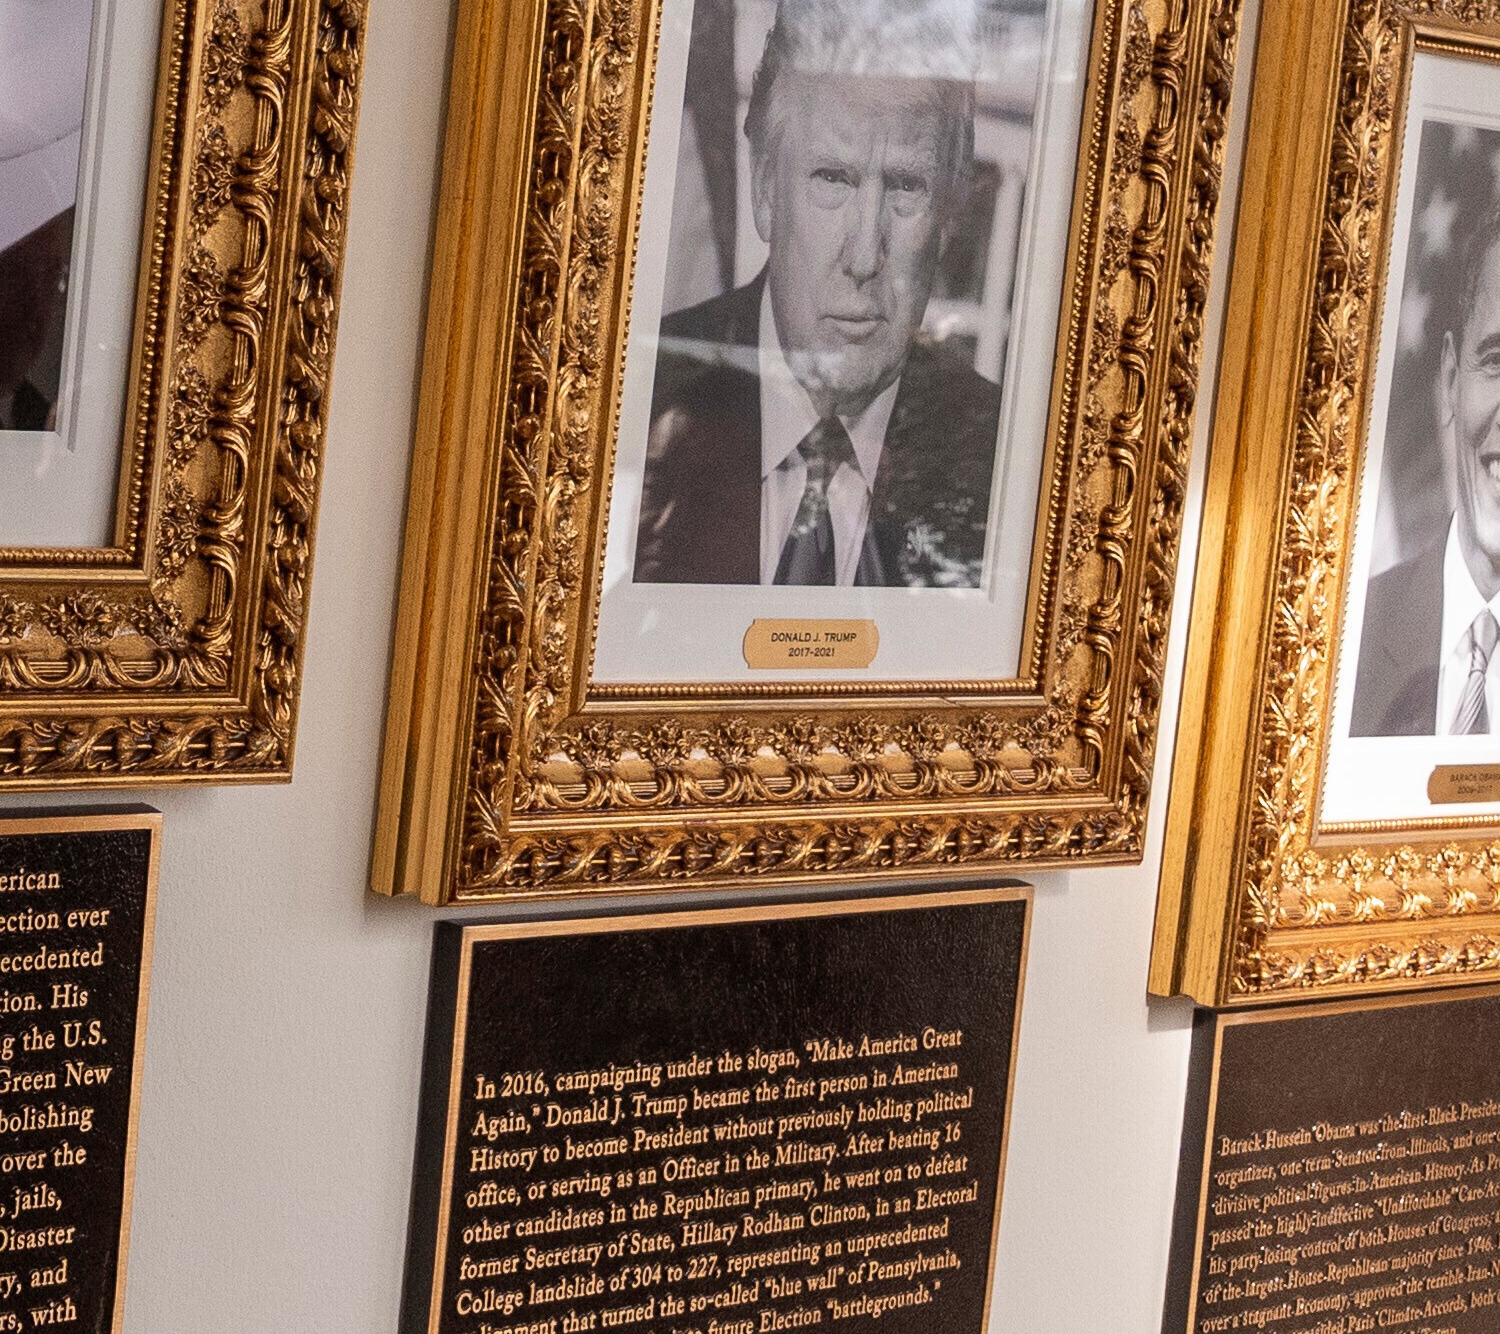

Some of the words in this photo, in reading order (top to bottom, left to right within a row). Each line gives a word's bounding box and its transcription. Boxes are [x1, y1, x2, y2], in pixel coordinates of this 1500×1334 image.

[771, 633, 811, 642] DONALD
[813, 633, 821, 642] J.
[824, 633, 857, 642] TRUMP
[788, 648, 835, 657] 2017-2021
[475, 1074, 496, 1100] In
[501, 1071, 550, 1097] 2016,
[554, 1060, 663, 1095] campaigning
[667, 1052, 713, 1080] under
[717, 1049, 743, 1074] the
[746, 1047, 800, 1075] slogan,
[855, 1033, 918, 1058] America
[922, 1026, 963, 1050] Great
[758, 1307, 821, 1334] Election
